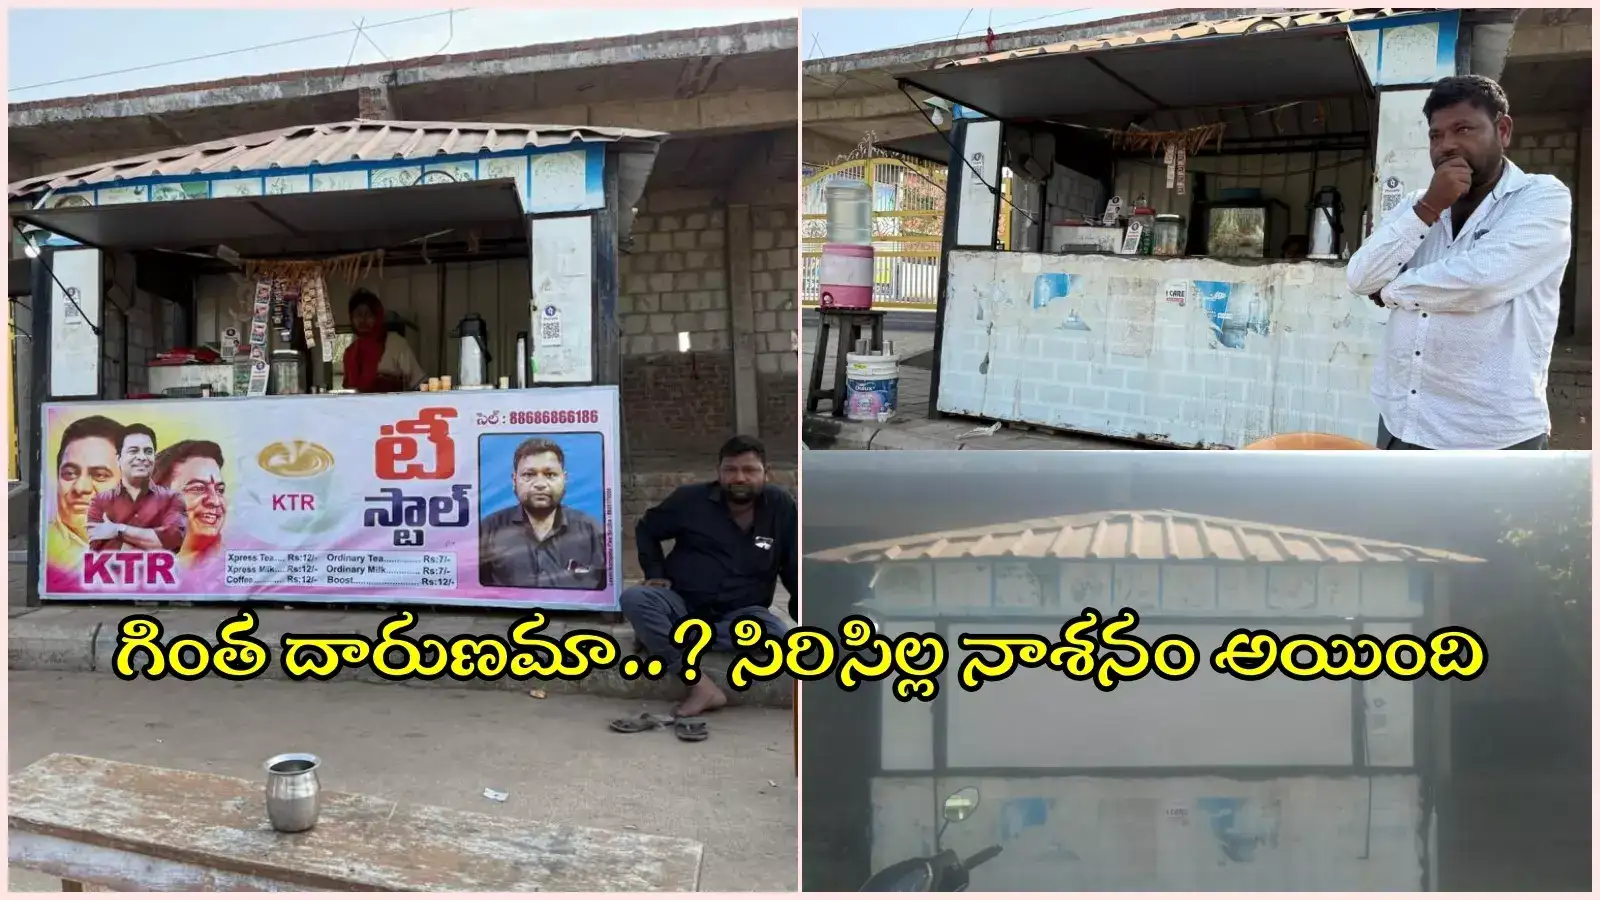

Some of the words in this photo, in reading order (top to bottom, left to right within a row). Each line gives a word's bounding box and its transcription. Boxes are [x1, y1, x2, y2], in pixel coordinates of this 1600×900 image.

[375, 407, 458, 480] టీ
[272, 494, 315, 511] KTR
[364, 484, 473, 547] స్టాల్
[228, 553, 258, 562] Xpress
[327, 553, 365, 564] Ordinary
[84, 551, 176, 585] KTR
[227, 565, 257, 573] Xpress
[326, 565, 365, 575] Ordinary
